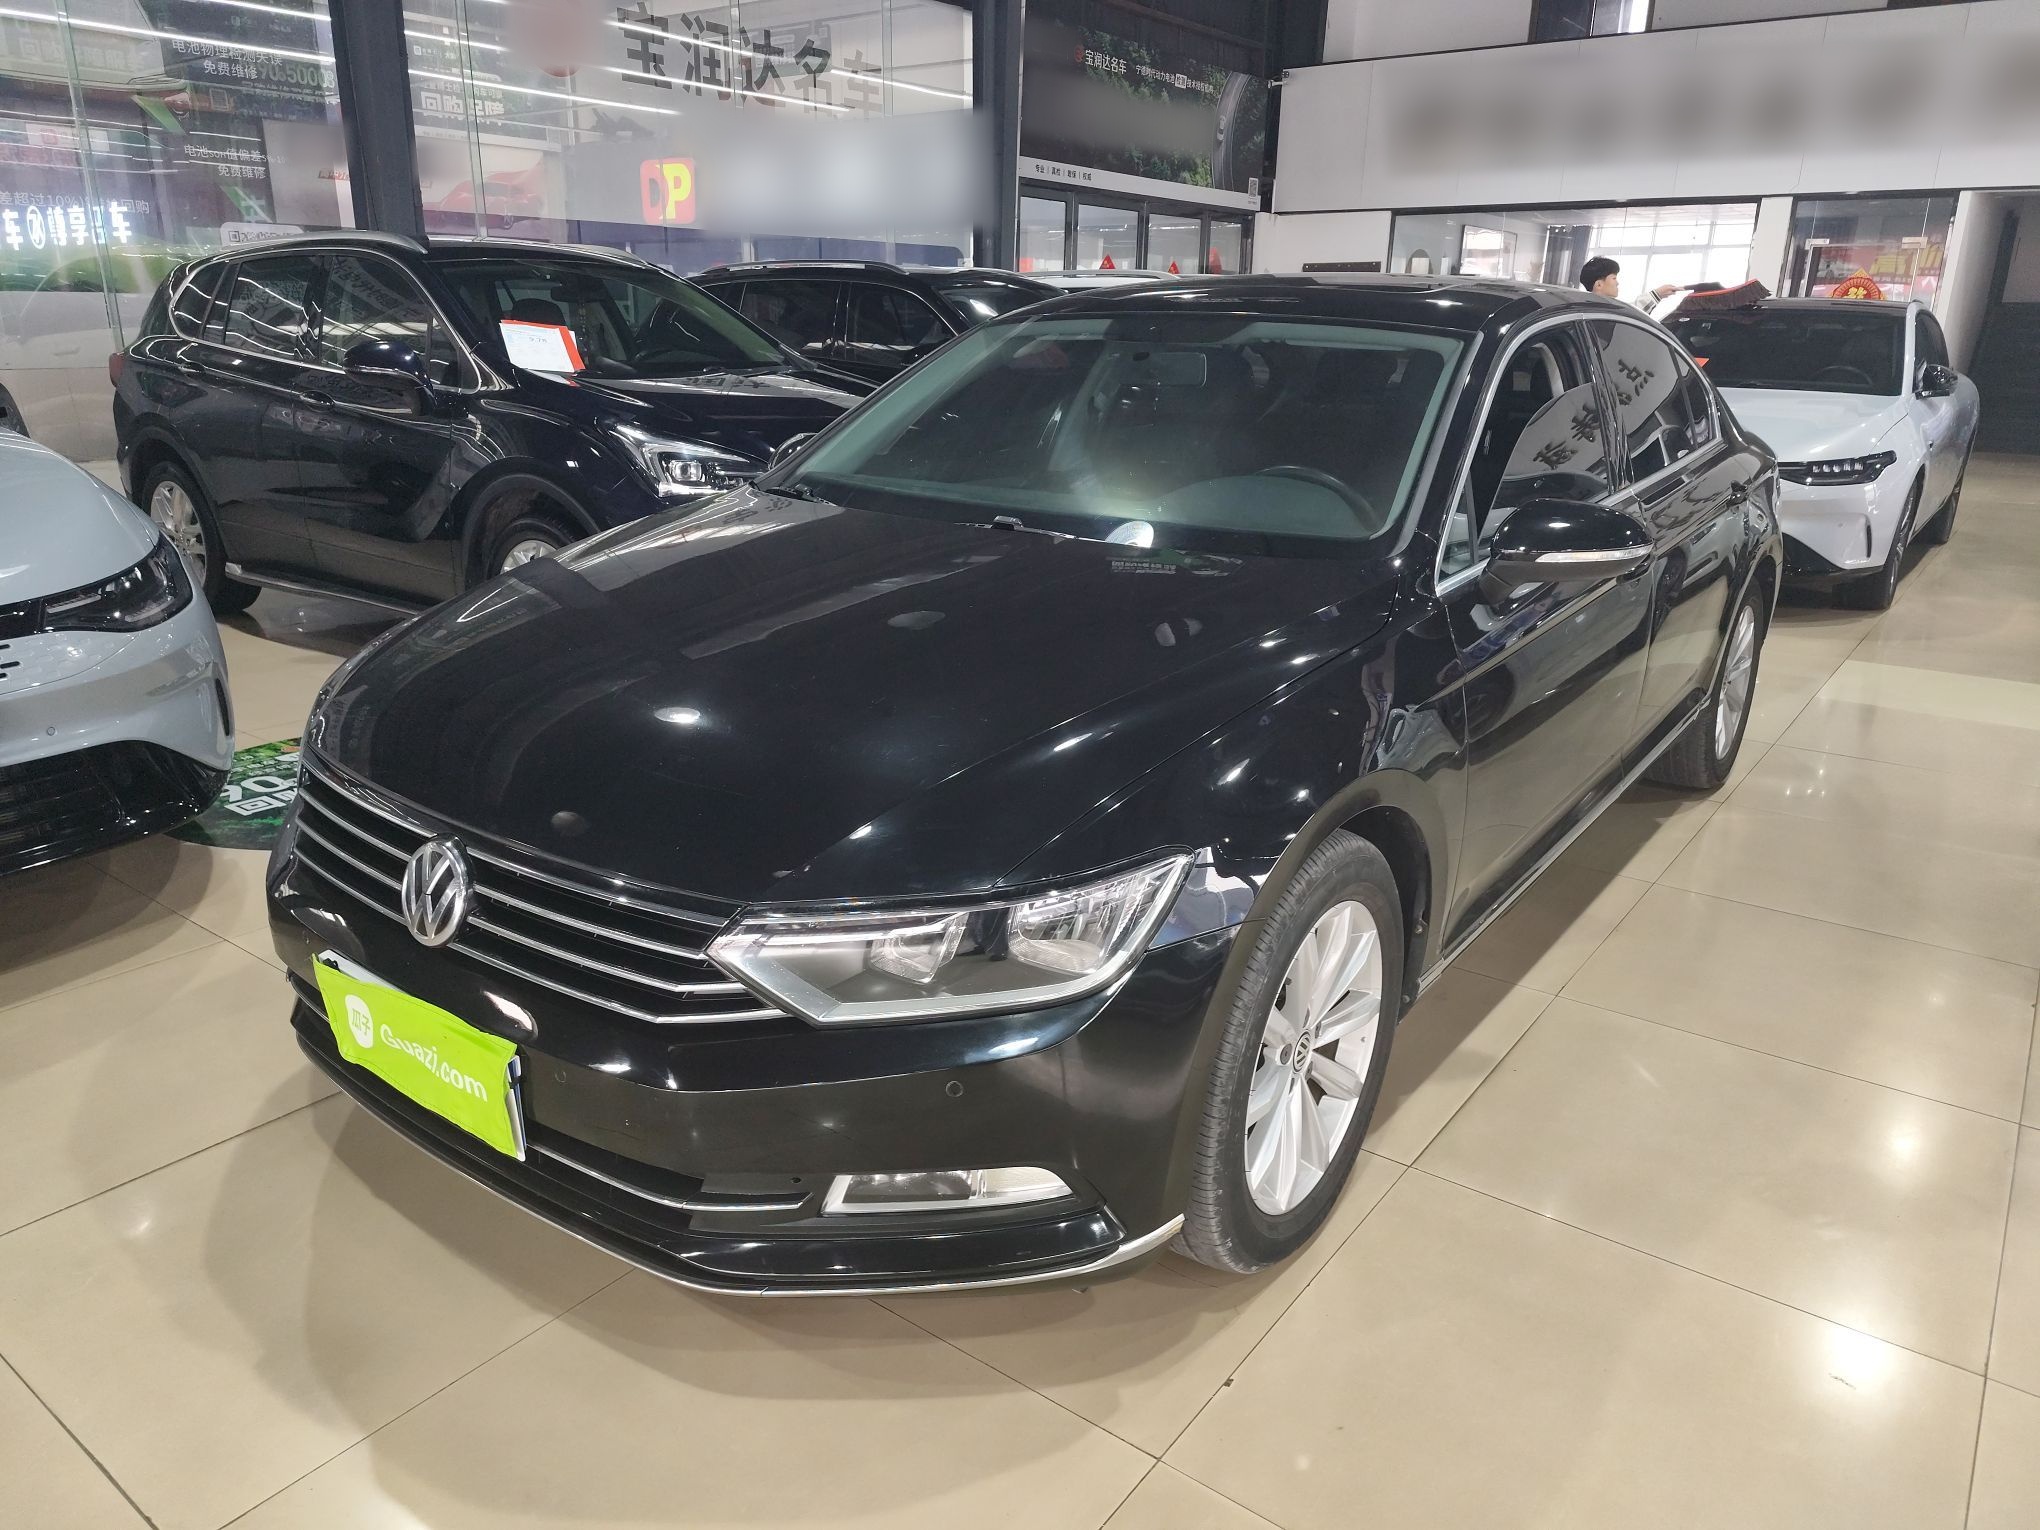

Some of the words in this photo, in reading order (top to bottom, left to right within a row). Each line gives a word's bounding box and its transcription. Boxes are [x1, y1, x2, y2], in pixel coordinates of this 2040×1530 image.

[203, 58, 258, 79] 免费维修
[616, 2, 884, 117] 宝润达名车
[1084, 49, 1127, 75] 宝润达名车
[380, 1023, 488, 1103] Guazi.com
